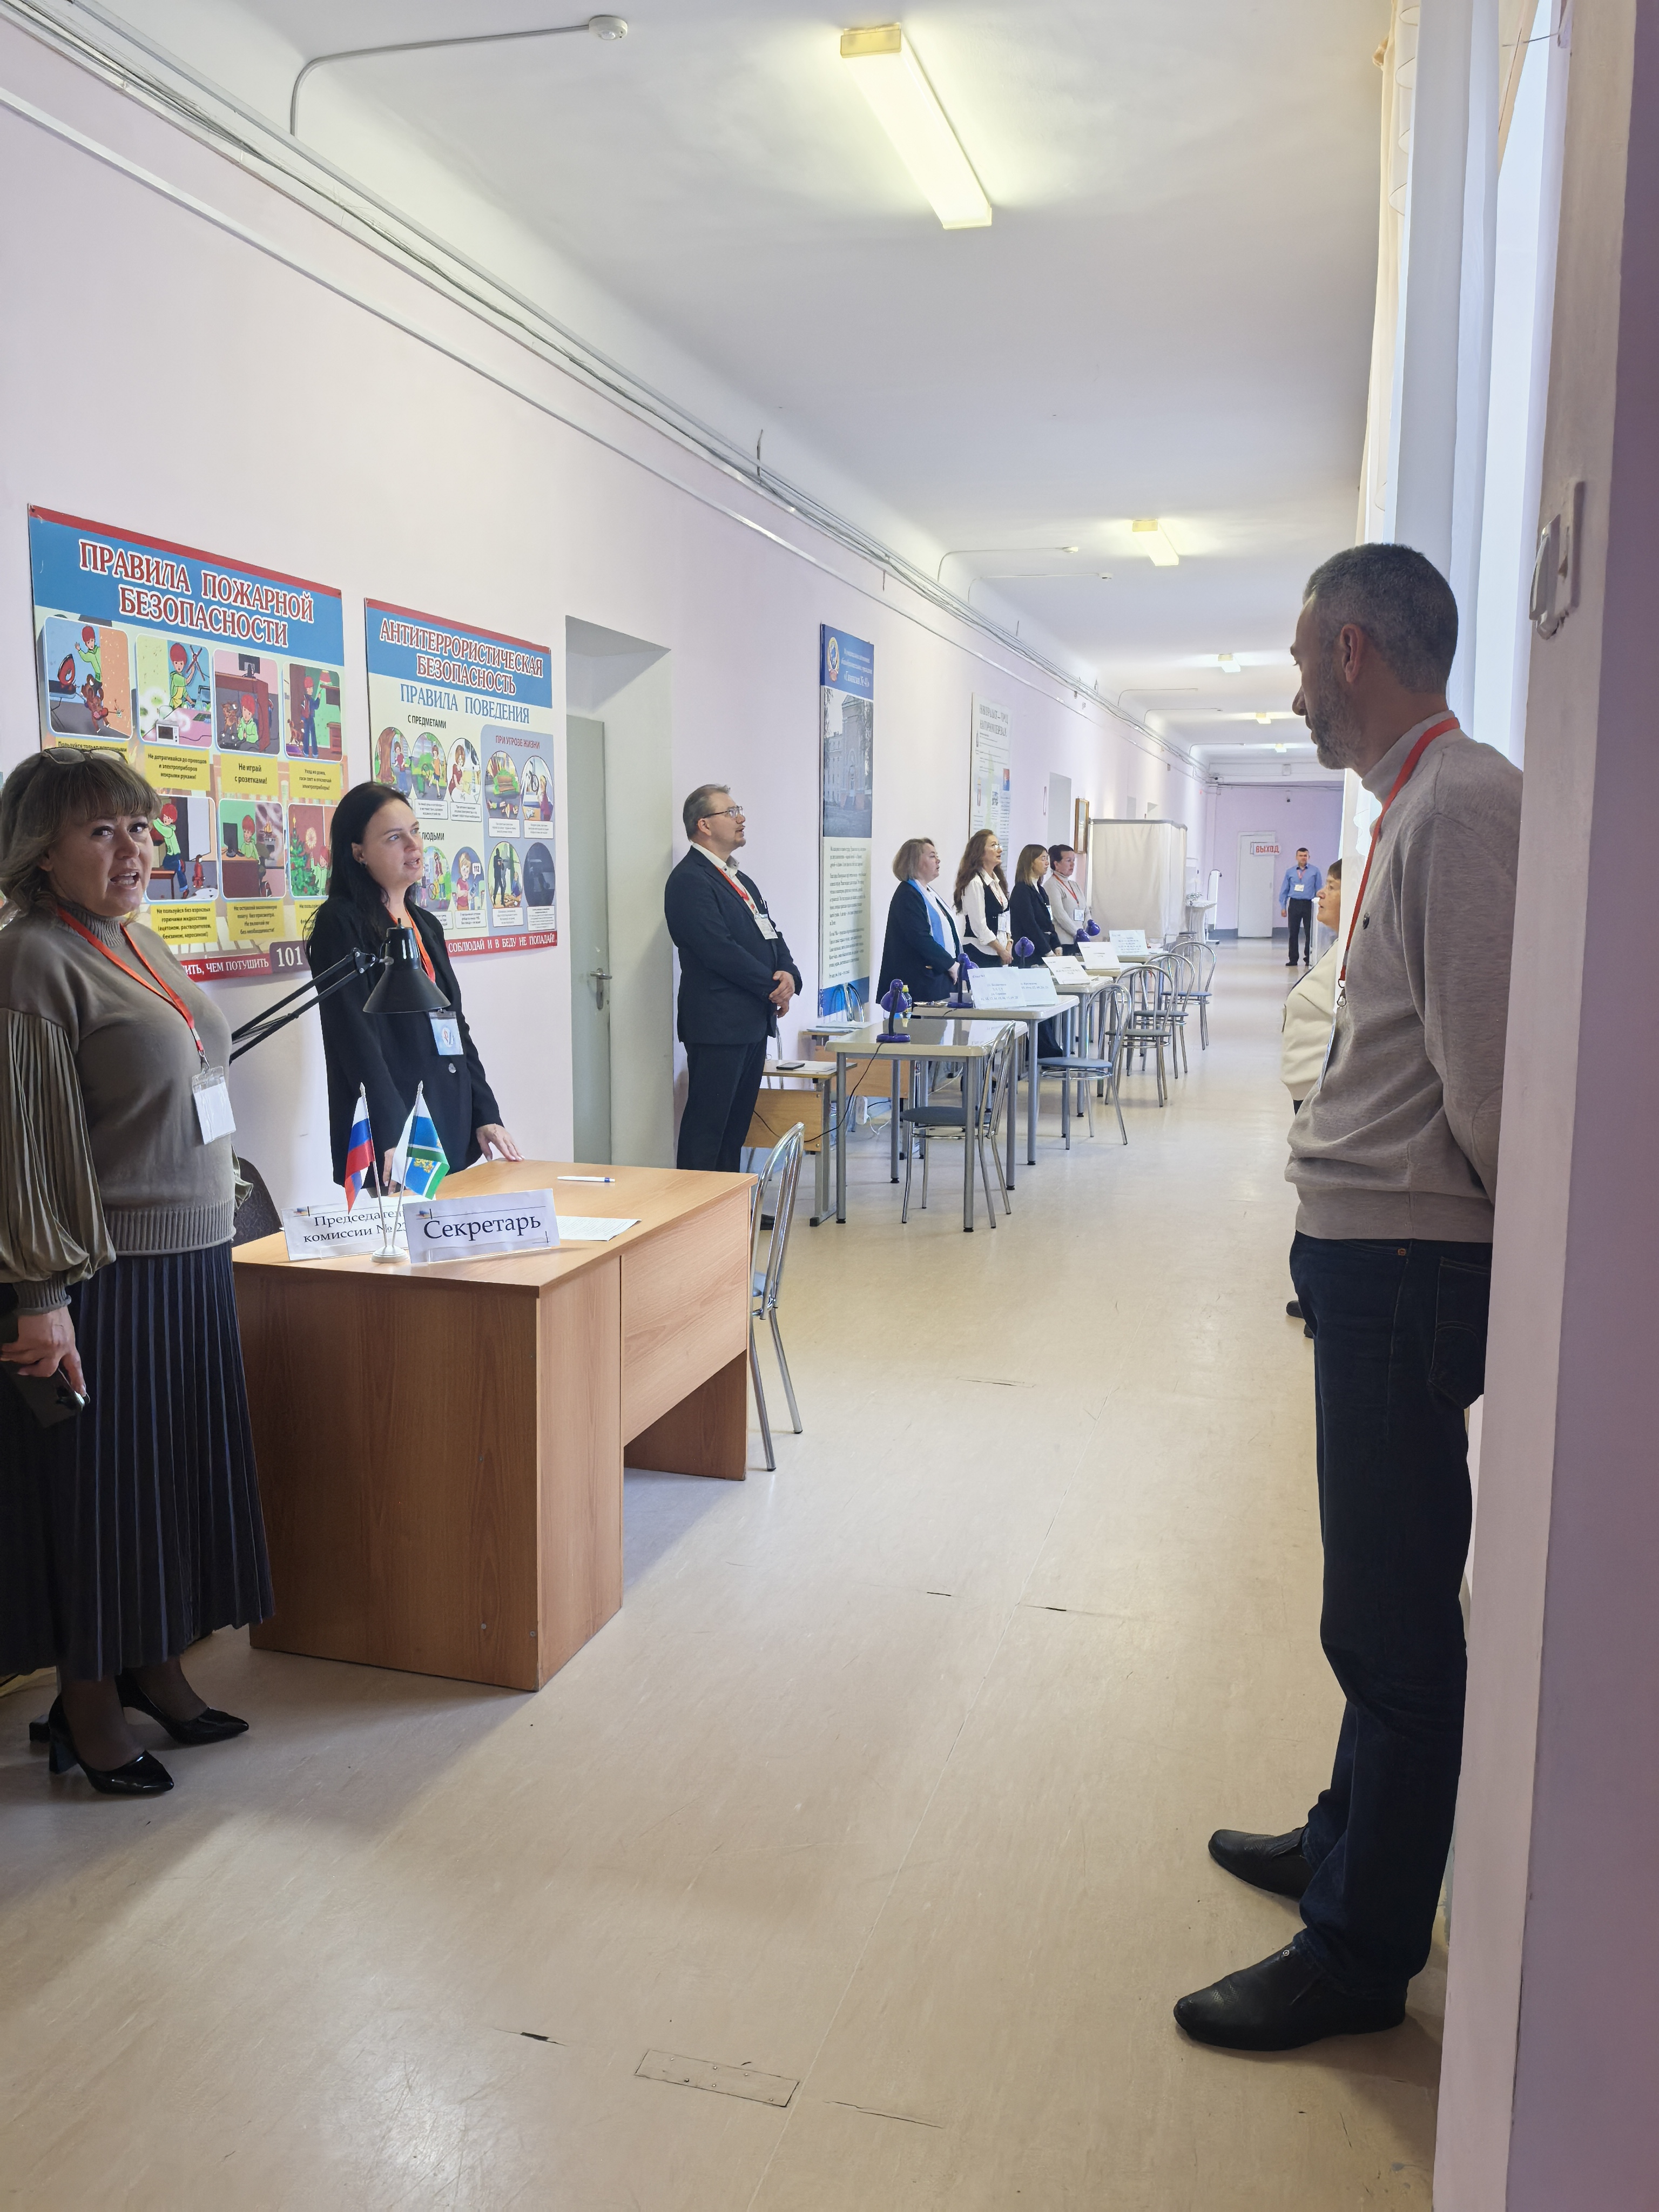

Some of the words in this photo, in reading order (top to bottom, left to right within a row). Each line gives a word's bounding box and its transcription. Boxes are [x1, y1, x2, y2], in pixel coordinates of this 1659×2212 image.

[79, 541, 190, 592] ПРАВИЛА
[201, 571, 314, 622] ПОЖАРНОЙ
[119, 586, 288, 647] БЕЗОПАСНОСТИ
[380, 619, 543, 677] АНТИТЕРРОРИСТИЧЕСКАЯ
[416, 655, 516, 694] БЕЗОПАСНОСТЬ
[400, 683, 458, 711] ПРАВИЛА
[464, 696, 530, 724] ПОВЕДЕНИЯ
[408, 715, 412, 723] С
[412, 715, 447, 729] ПРЕДМЕТАМИ
[495, 735, 505, 744] ПРИ
[506, 737, 523, 747] УГРОЗЕ
[523, 739, 540, 750] ЖИЗНИ
[238, 763, 246, 771] Не
[246, 765, 261, 773] играй
[238, 775, 267, 784] розетками!
[422, 832, 444, 841] ЛЮДЬМИ
[1256, 845, 1279, 853] ВЫХОД
[448, 939, 485, 953] СОБЛЮДАЙ
[487, 940, 493, 949] И
[495, 939, 500, 947] В
[502, 938, 516, 947] БЕДУ
[519, 936, 527, 945] НЕ
[529, 933, 555, 945] ПОПАДАЙ!
[276, 946, 304, 967] 101
[183, 964, 204, 975] ИТЬ,
[206, 962, 224, 972] ЧЕМ
[226, 958, 269, 971] ПОТУШИТЬ
[314, 1210, 404, 1228] Председател
[423, 1216, 541, 1241] Секретарь
[304, 1228, 373, 1243] комиссии
[376, 1224, 393, 1234] №
